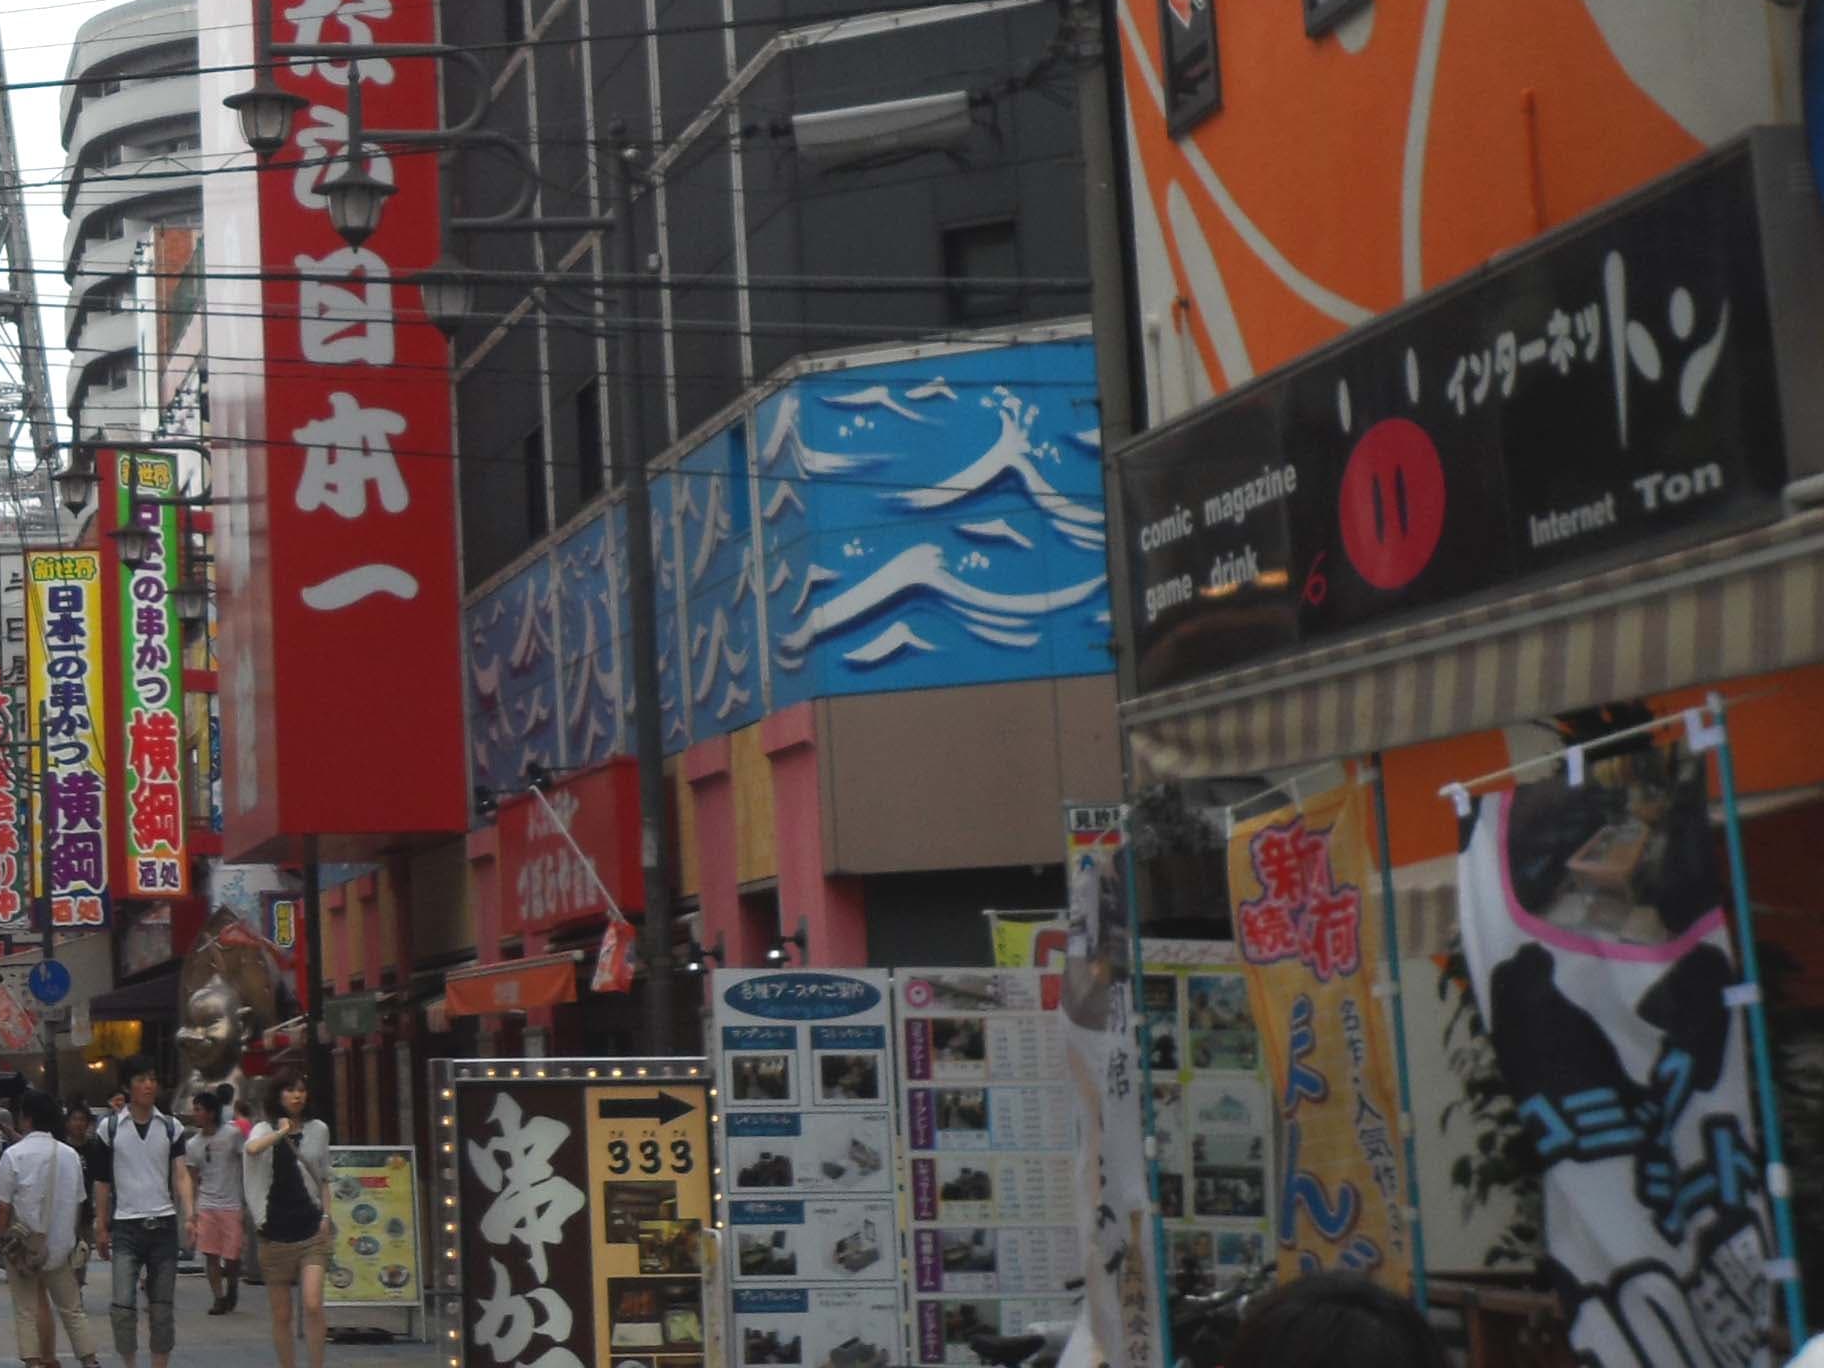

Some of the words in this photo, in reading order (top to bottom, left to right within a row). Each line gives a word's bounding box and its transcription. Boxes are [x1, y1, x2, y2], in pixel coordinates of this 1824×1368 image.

[1139, 506, 1194, 553] comic
[1204, 463, 1298, 533] magazine
[1529, 490, 1617, 548] Internet
[1633, 462, 1724, 513] Ton
[33, 558, 96, 580] 新世界
[1145, 571, 1194, 623] game
[1210, 546, 1260, 595] drink
[139, 860, 179, 888] 酒処
